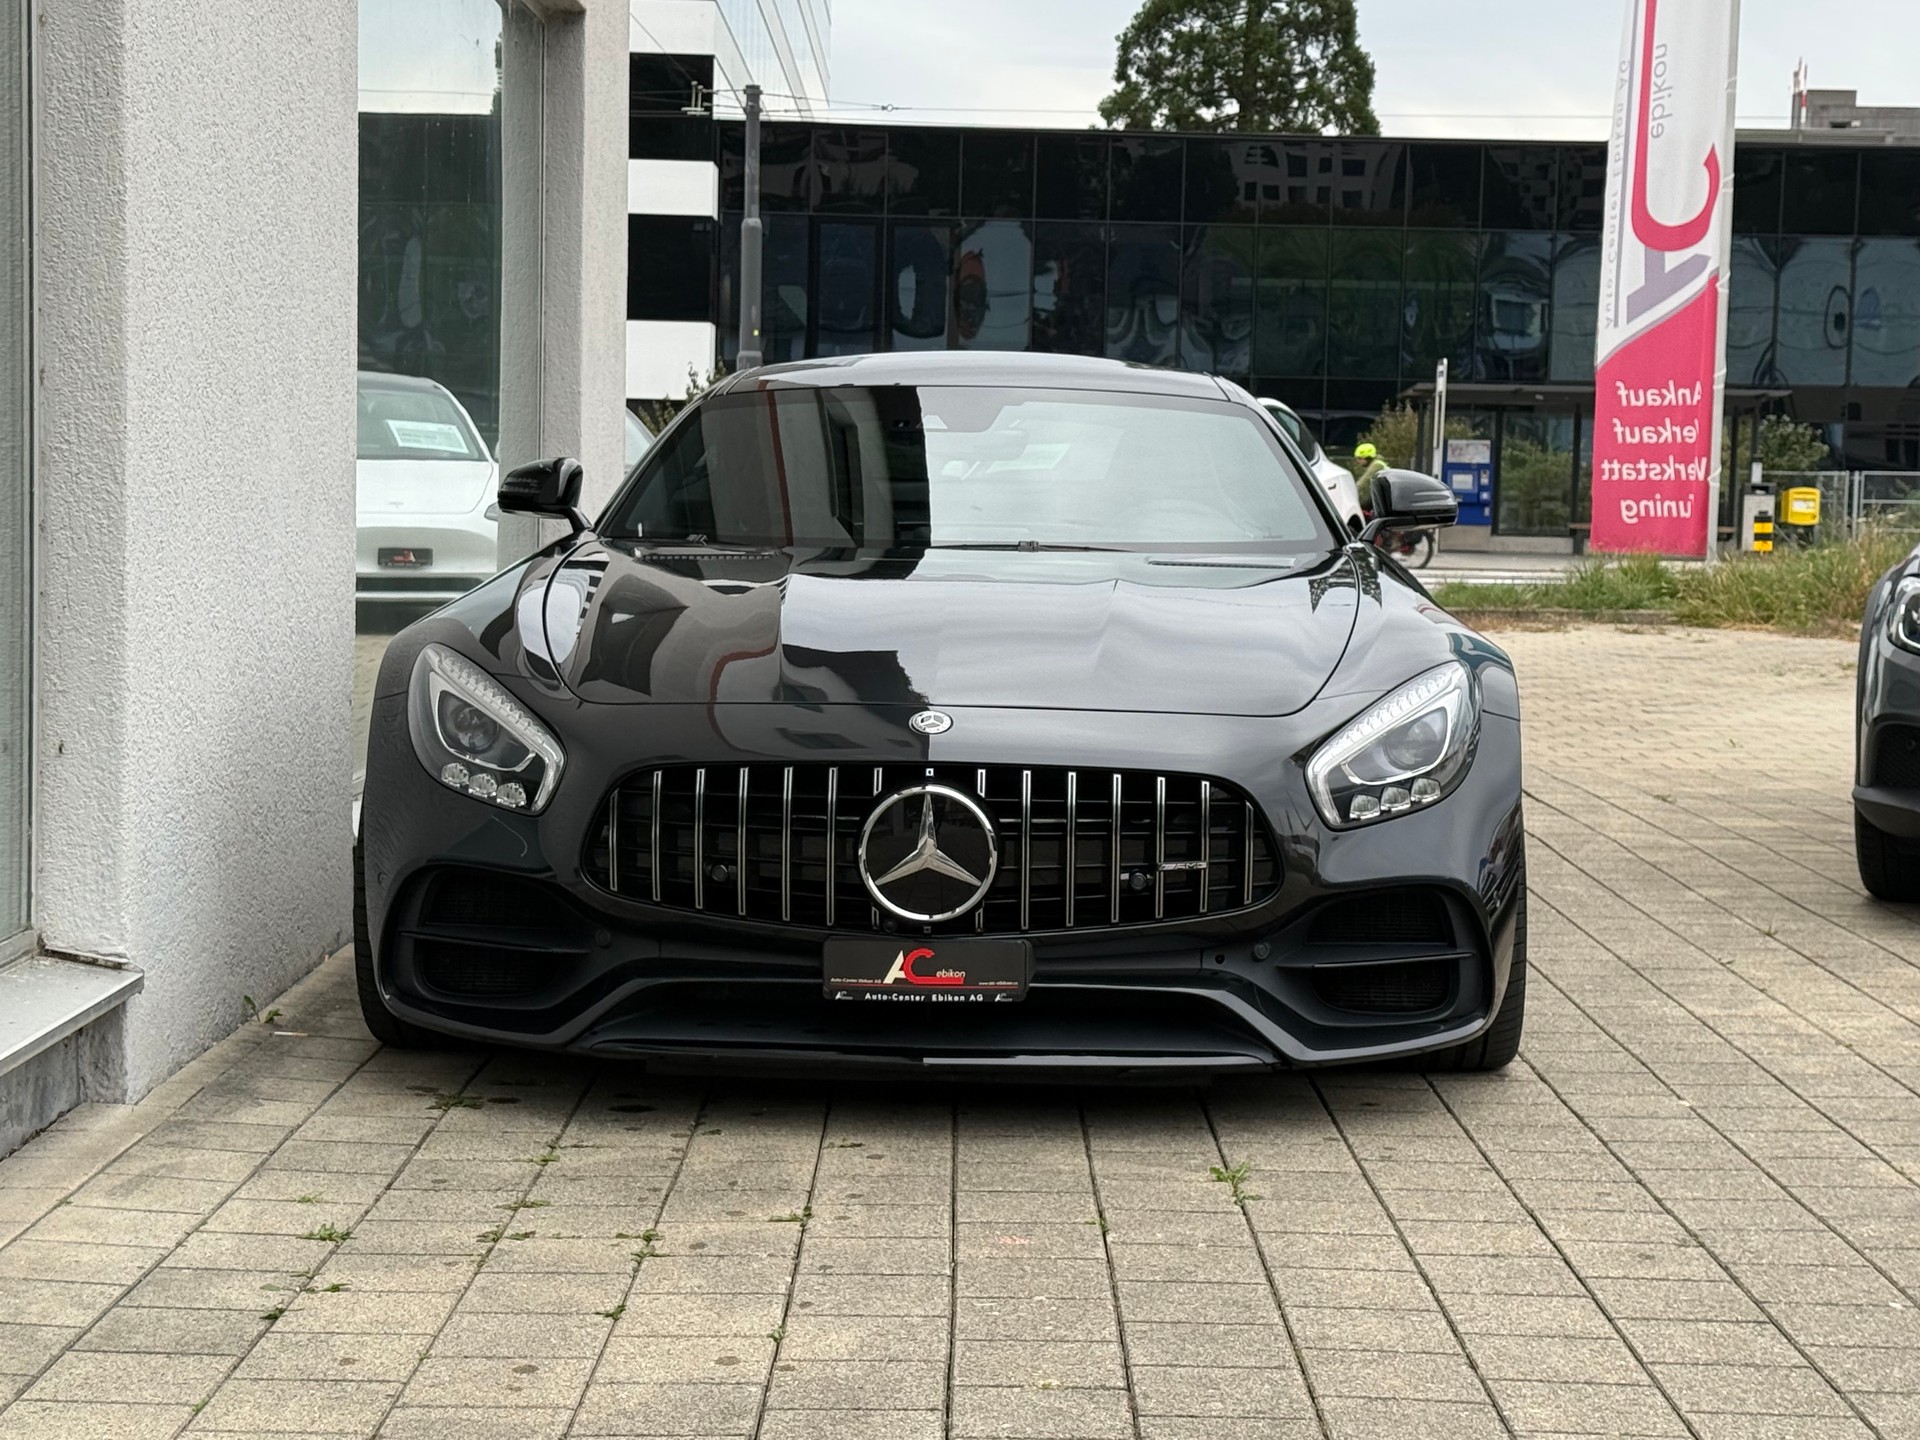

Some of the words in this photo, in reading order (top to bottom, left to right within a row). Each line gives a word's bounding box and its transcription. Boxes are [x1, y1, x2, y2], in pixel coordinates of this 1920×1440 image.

[936, 968, 966, 978] ebikon
[864, 992, 925, 1001] Auto-Center
[932, 992, 965, 1001] Ebikon
[969, 993, 984, 1002] AG
